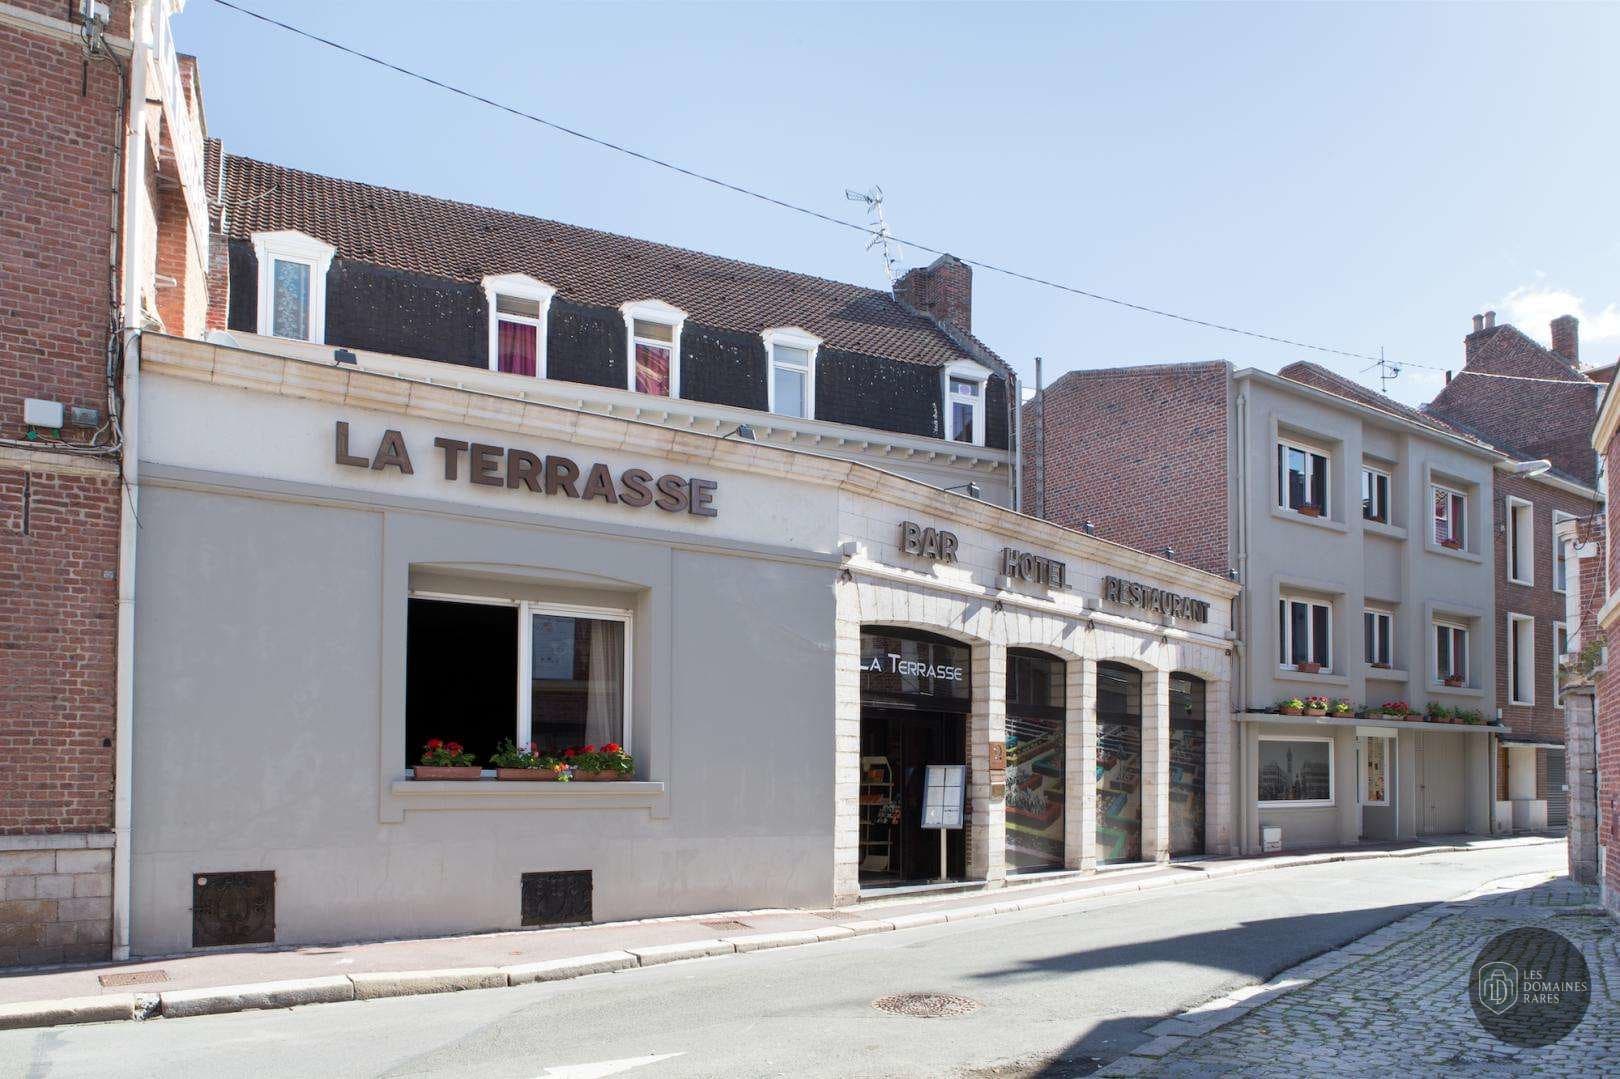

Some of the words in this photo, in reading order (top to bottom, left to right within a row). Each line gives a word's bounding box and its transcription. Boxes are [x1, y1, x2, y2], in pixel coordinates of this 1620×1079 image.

[335, 421, 414, 475] LA
[434, 437, 718, 517] TERRASSE
[900, 520, 959, 563] BAR
[1001, 547, 1072, 591] HOTEL
[1102, 575, 1211, 624] RESTAURANT
